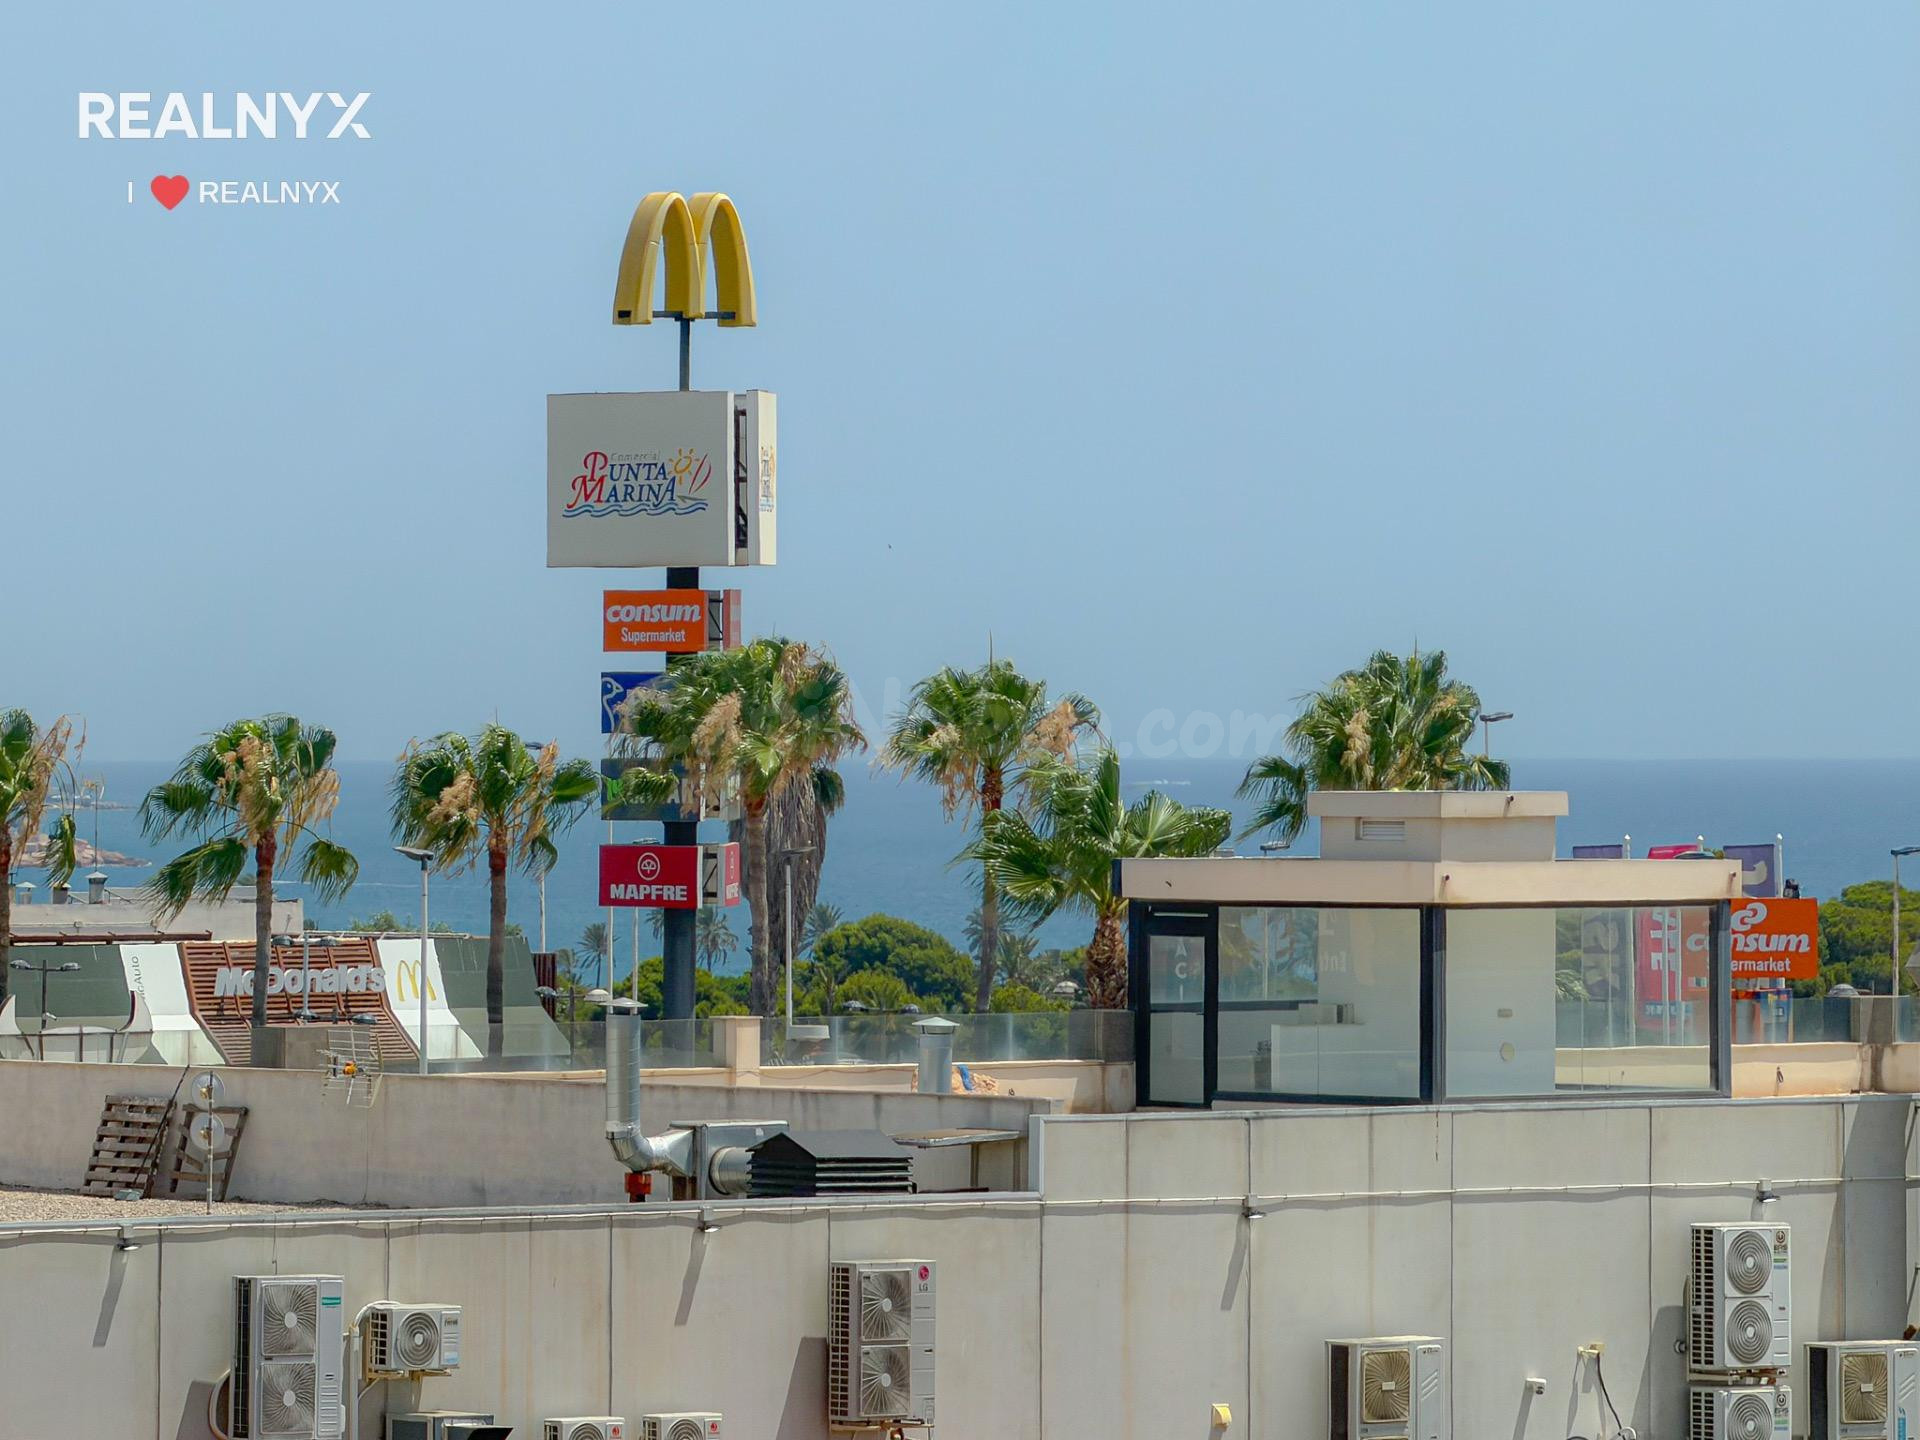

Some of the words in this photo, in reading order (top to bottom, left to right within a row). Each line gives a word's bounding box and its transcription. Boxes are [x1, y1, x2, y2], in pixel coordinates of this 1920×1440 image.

[583, 451, 668, 481] PUNTA
[567, 475, 676, 507] MARINA
[606, 603, 701, 623] consum
[620, 627, 686, 643] Supermarket
[610, 883, 688, 901] MAPFRE
[213, 965, 387, 997] McDonald's
[918, 1283, 928, 1291] LG
